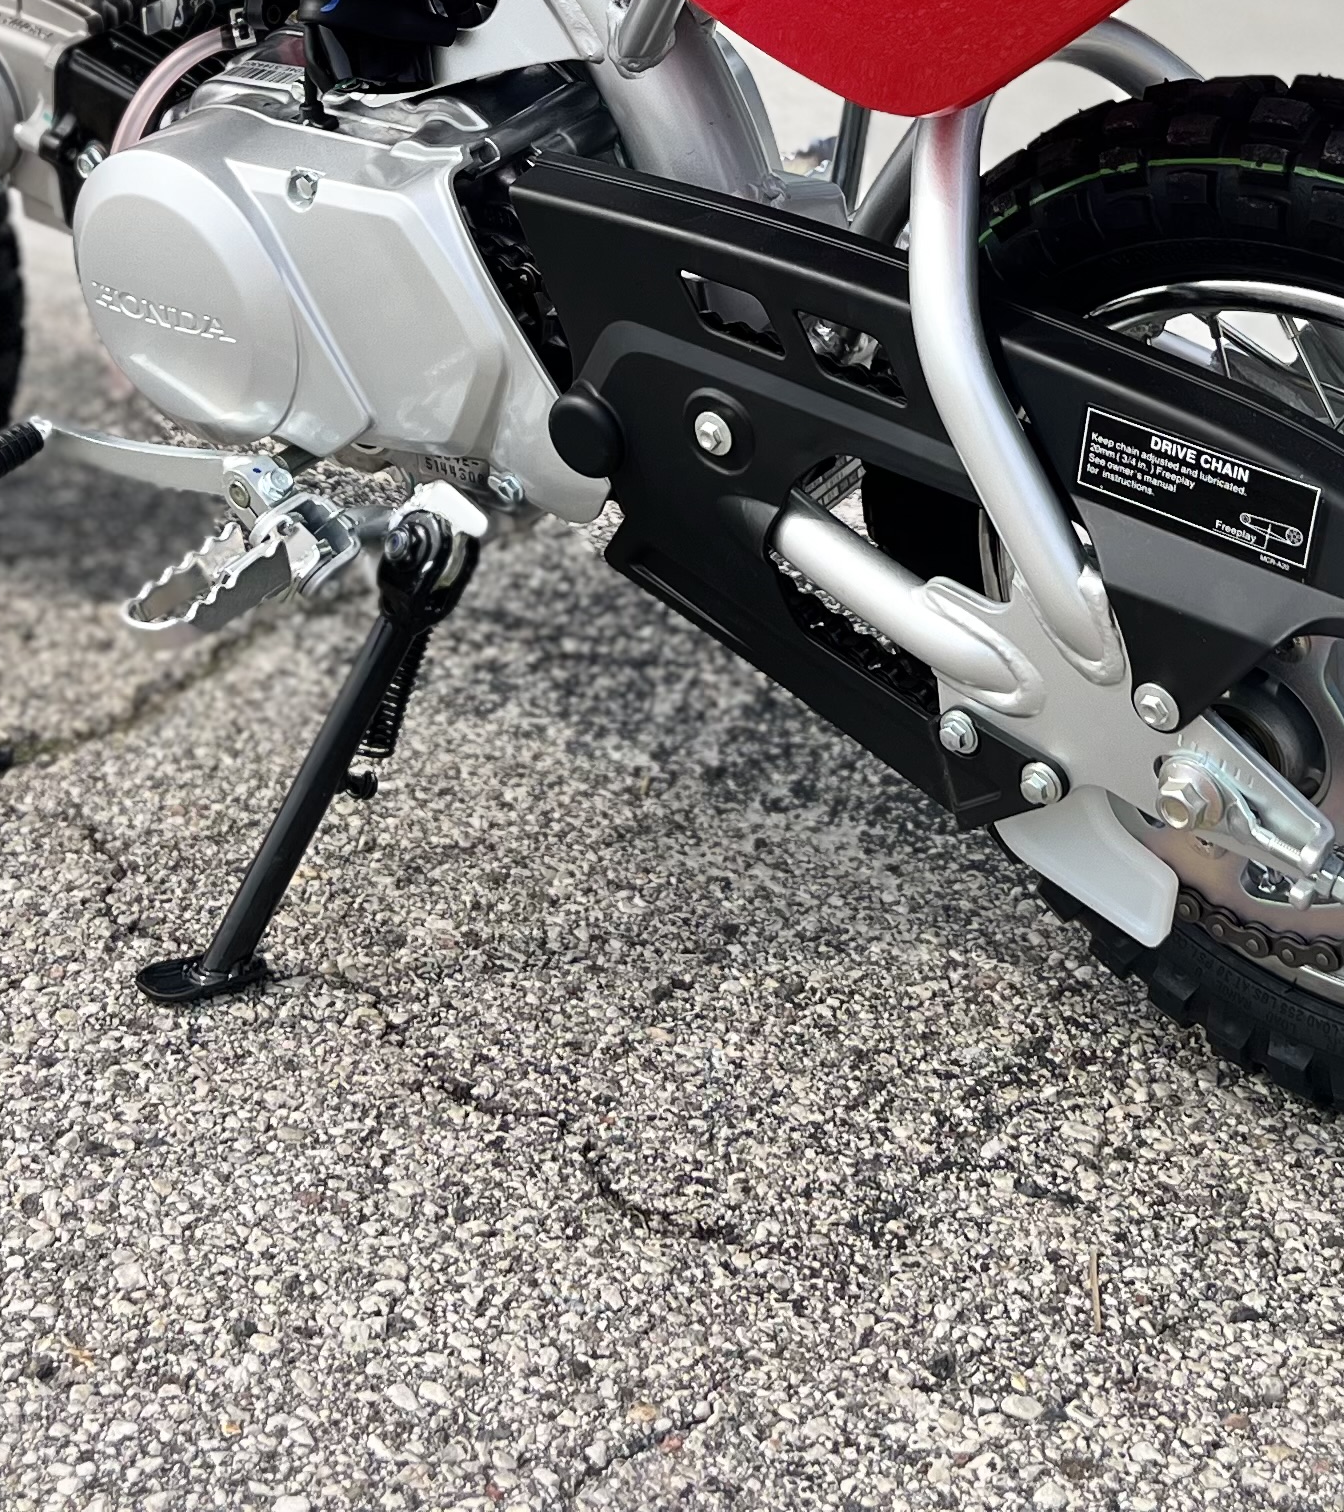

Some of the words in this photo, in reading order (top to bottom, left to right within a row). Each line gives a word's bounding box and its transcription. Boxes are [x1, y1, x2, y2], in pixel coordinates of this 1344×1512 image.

[91, 280, 237, 344] HONDA
[1088, 453, 1106, 467] See
[1091, 432, 1114, 451] Keep
[1115, 441, 1140, 457] chain
[1140, 448, 1179, 472] adjusted
[1180, 462, 1198, 478] and
[1150, 435, 1197, 465] DRIVE
[1199, 454, 1250, 483] CHAIN
[1156, 465, 1196, 490] Freeplay
[1215, 519, 1257, 545] Freeplay
